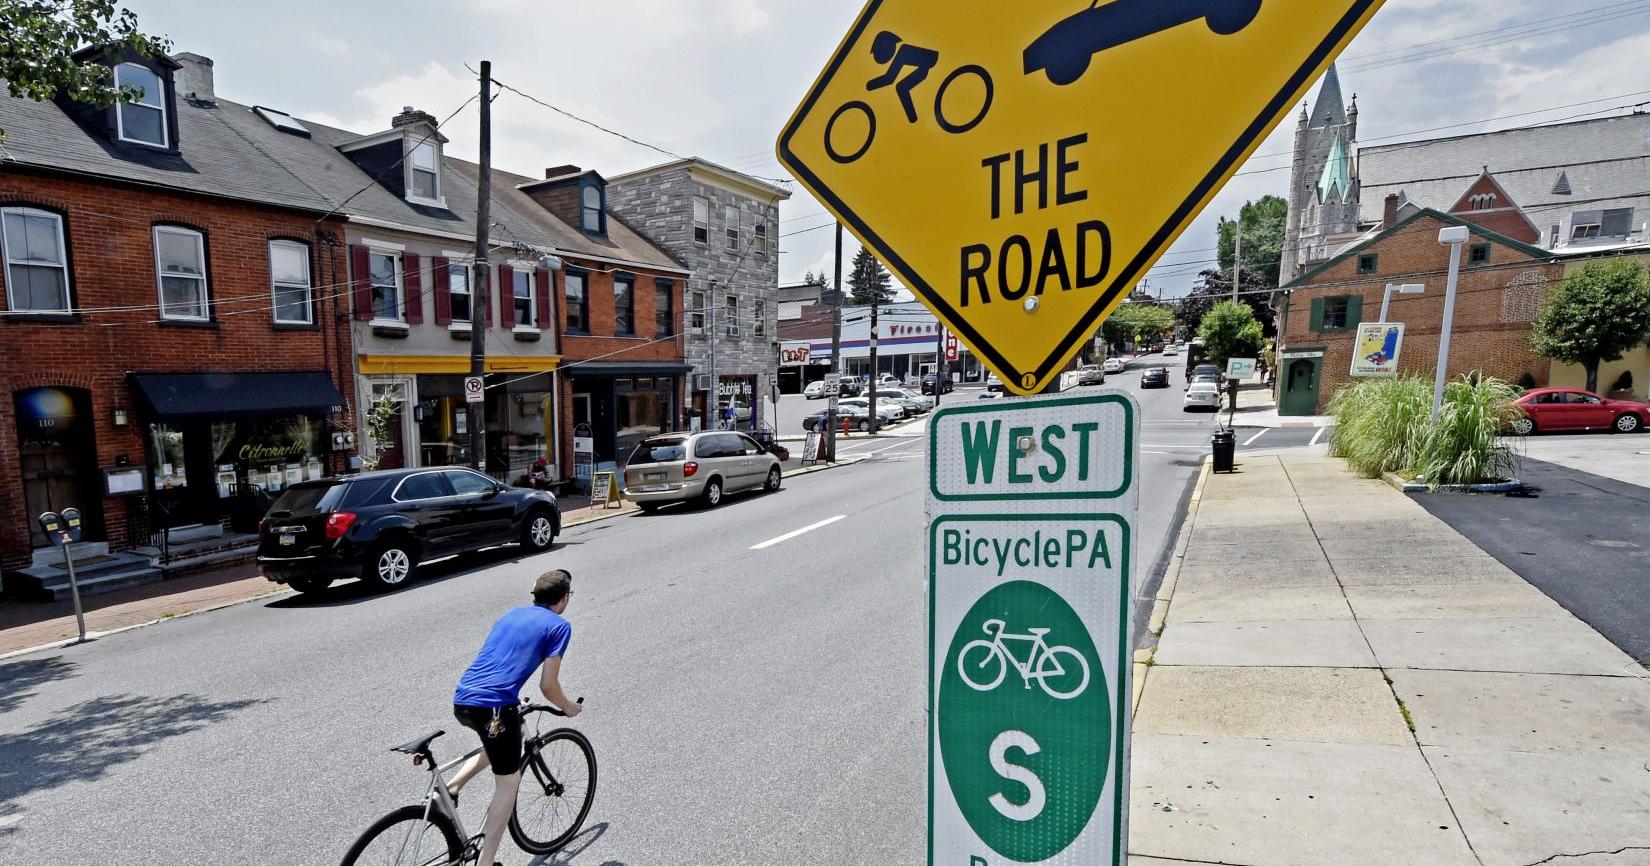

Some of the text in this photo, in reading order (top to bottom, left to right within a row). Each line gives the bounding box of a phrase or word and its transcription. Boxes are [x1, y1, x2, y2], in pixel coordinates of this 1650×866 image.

[982, 133, 1088, 220] THE
[960, 220, 1111, 307] ROAD
[331, 404, 342, 413] 110
[742, 382, 752, 394] Tea
[826, 384, 838, 393] 25
[39, 418, 55, 428] 110
[961, 420, 1099, 485] WEST
[943, 528, 1112, 577] BicyclePA
[988, 729, 1047, 822] S
